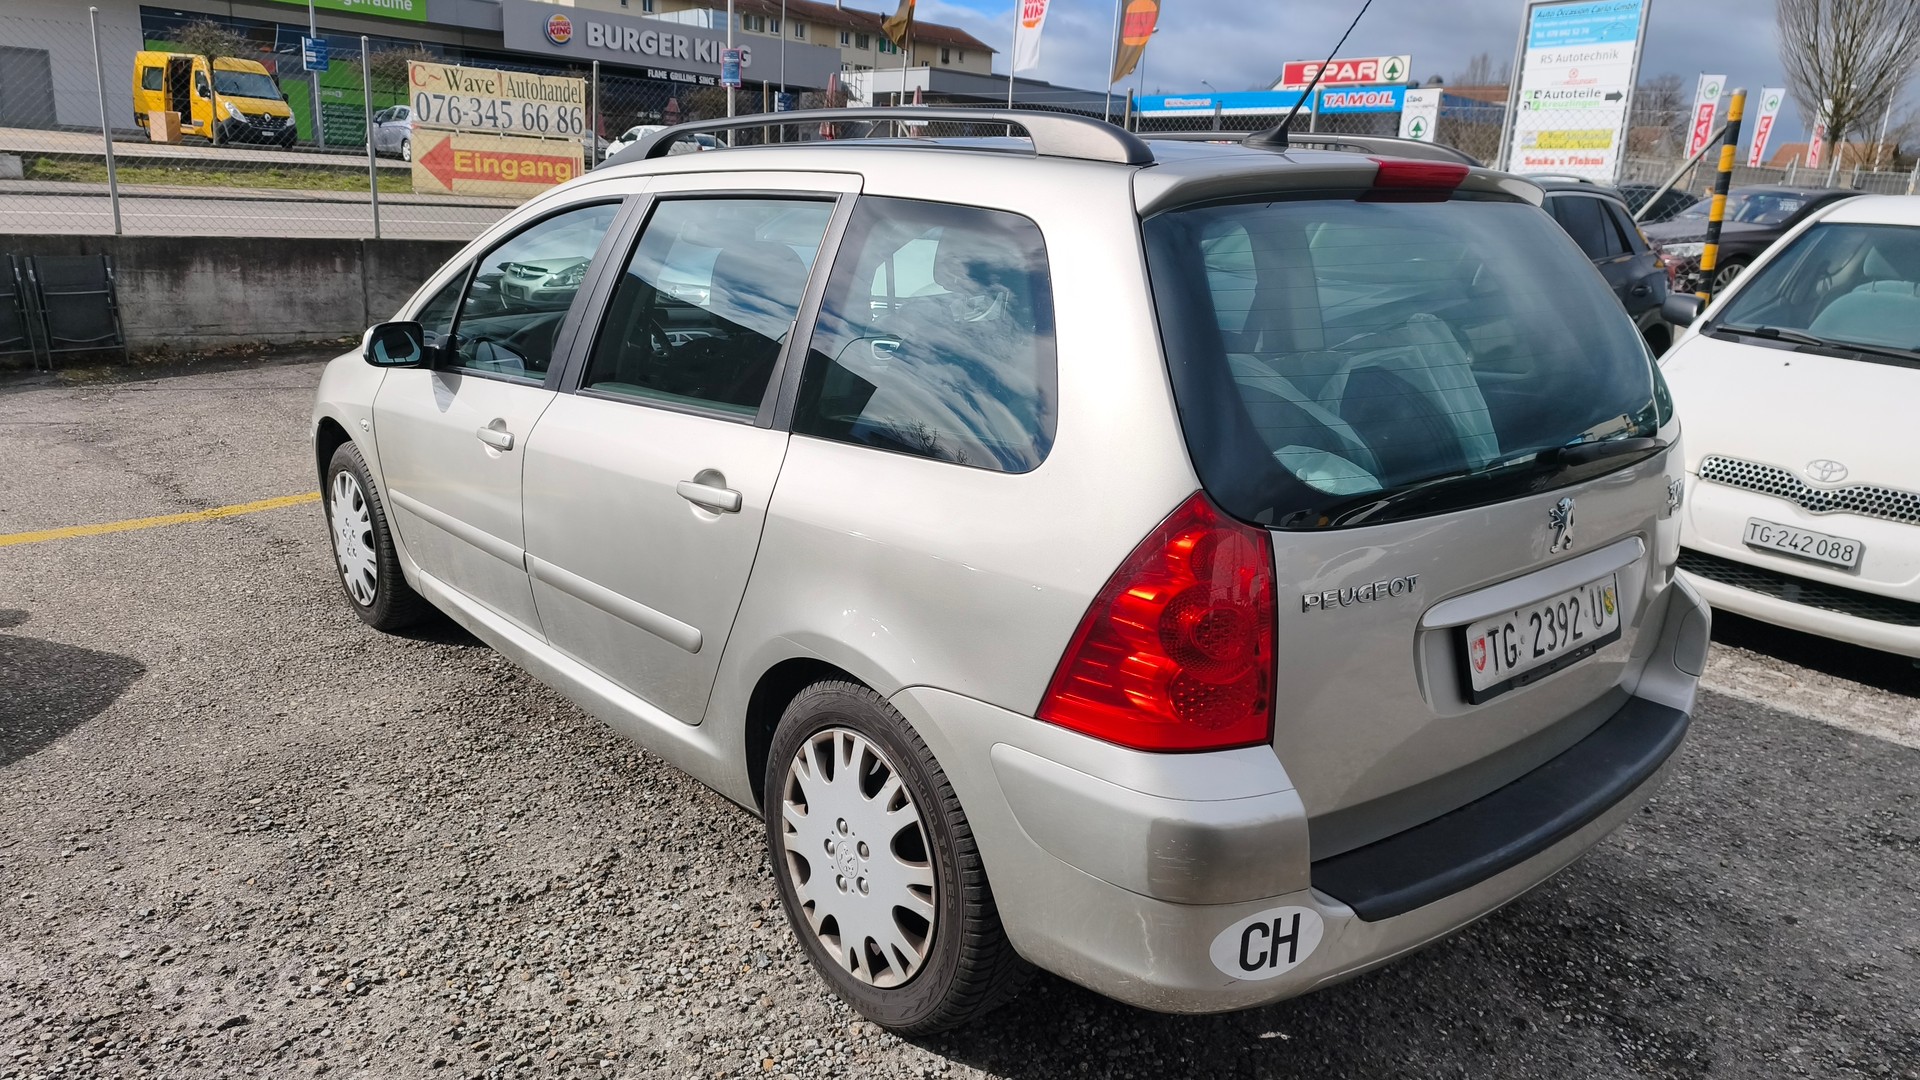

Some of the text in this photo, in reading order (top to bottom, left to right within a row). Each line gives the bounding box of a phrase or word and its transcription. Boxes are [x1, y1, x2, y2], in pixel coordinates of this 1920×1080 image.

[550, 26, 571, 35] KING
[587, 21, 689, 60] BURGER
[1302, 61, 1377, 82] SPAR
[1540, 50, 1620, 64] RS Autotechnik
[506, 75, 583, 104] Autohandel
[647, 69, 668, 80] FLAME
[670, 73, 697, 83] GRILLING
[699, 76, 715, 86] SINCE
[1324, 91, 1395, 106] TAMOIL
[1543, 88, 1602, 99] Autoteile
[416, 91, 583, 135] 076-345 66 86
[1692, 106, 1713, 153] PAR
[454, 151, 573, 183] Eingang
[1302, 573, 1420, 613] PEUGEOT
[1529, 596, 1583, 659] 2392
[1589, 585, 1605, 631] U
[1238, 912, 1301, 972] CH
